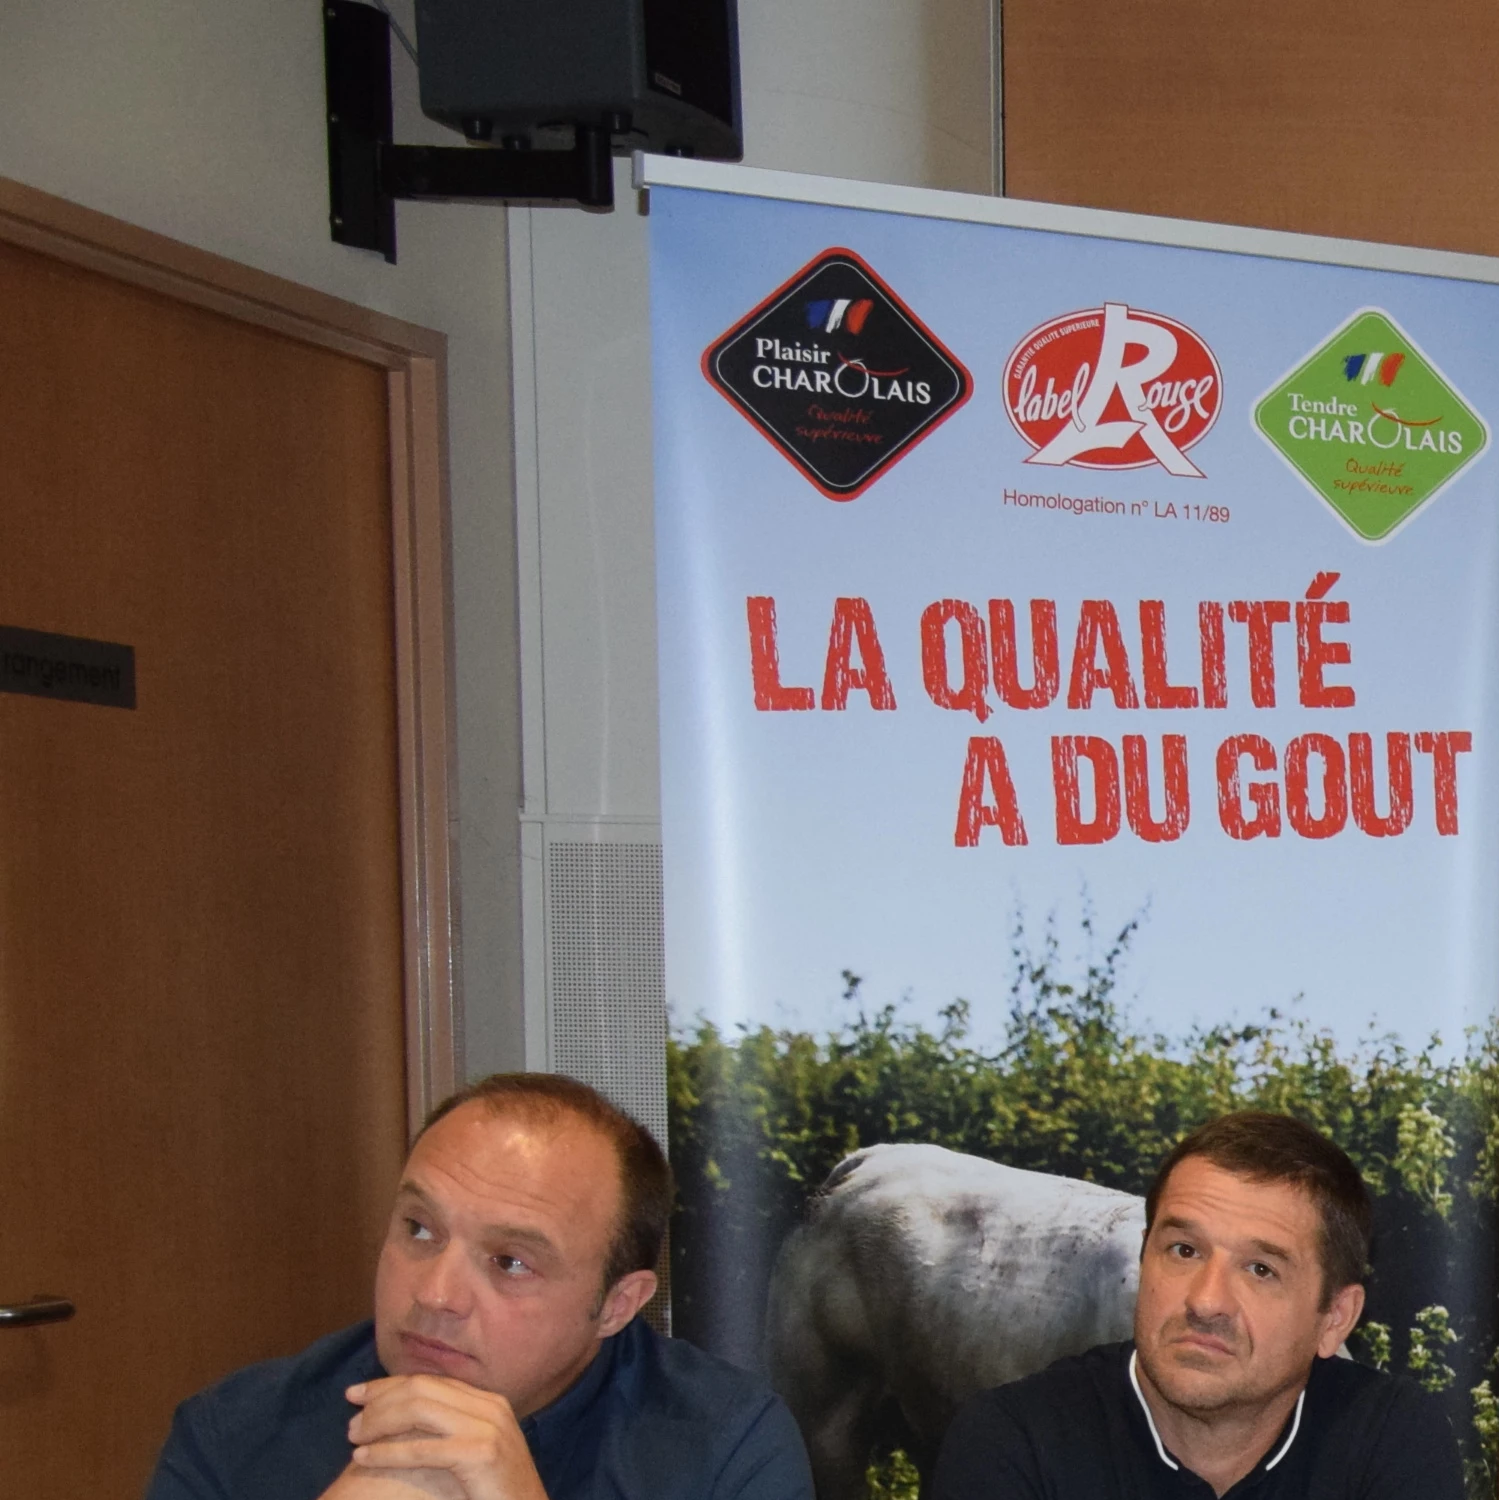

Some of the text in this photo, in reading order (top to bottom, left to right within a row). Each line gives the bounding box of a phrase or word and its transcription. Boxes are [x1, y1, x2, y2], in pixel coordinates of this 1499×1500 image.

[755, 338, 830, 365] Plaisir
[1014, 347, 1034, 379] GARANTIE
[752, 359, 932, 405] CHAROLAIS
[1014, 363, 1089, 432] label
[1287, 392, 1357, 416] Tendre
[1288, 407, 1463, 454] CHAROLAIS
[1346, 458, 1407, 477] Qualité
[1003, 488, 1230, 523] Homologation n° LA 11/89
[745, 571, 1356, 724] LA QUALITÉ
[954, 731, 1472, 849] A DU GOUT
